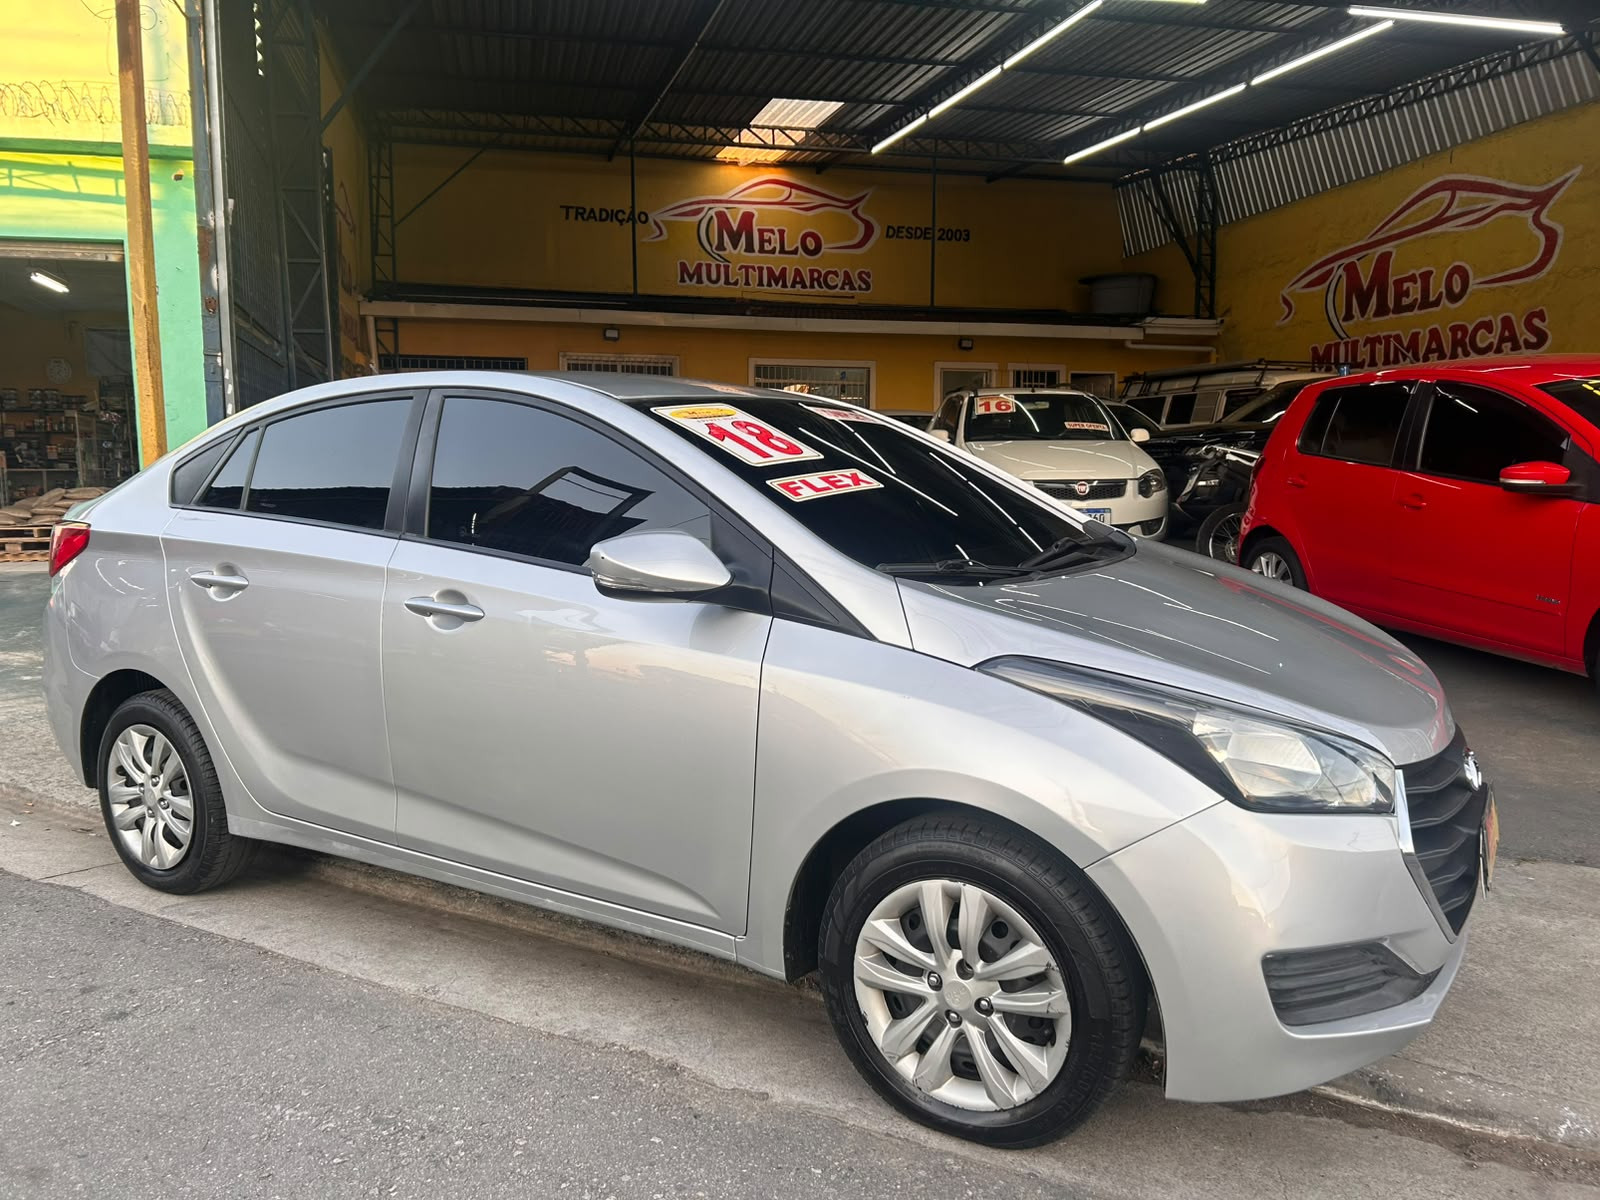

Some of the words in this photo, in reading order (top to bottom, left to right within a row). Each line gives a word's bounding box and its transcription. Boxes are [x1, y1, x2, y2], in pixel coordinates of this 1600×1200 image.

[886, 225, 933, 240] DESDE
[937, 227, 971, 242] 2003
[679, 261, 872, 292] MULTIMARCAS
[1310, 308, 1550, 373] MULTIMARCAS
[979, 400, 1011, 412] 16
[705, 420, 804, 459] 18
[775, 472, 874, 497] FLEX
